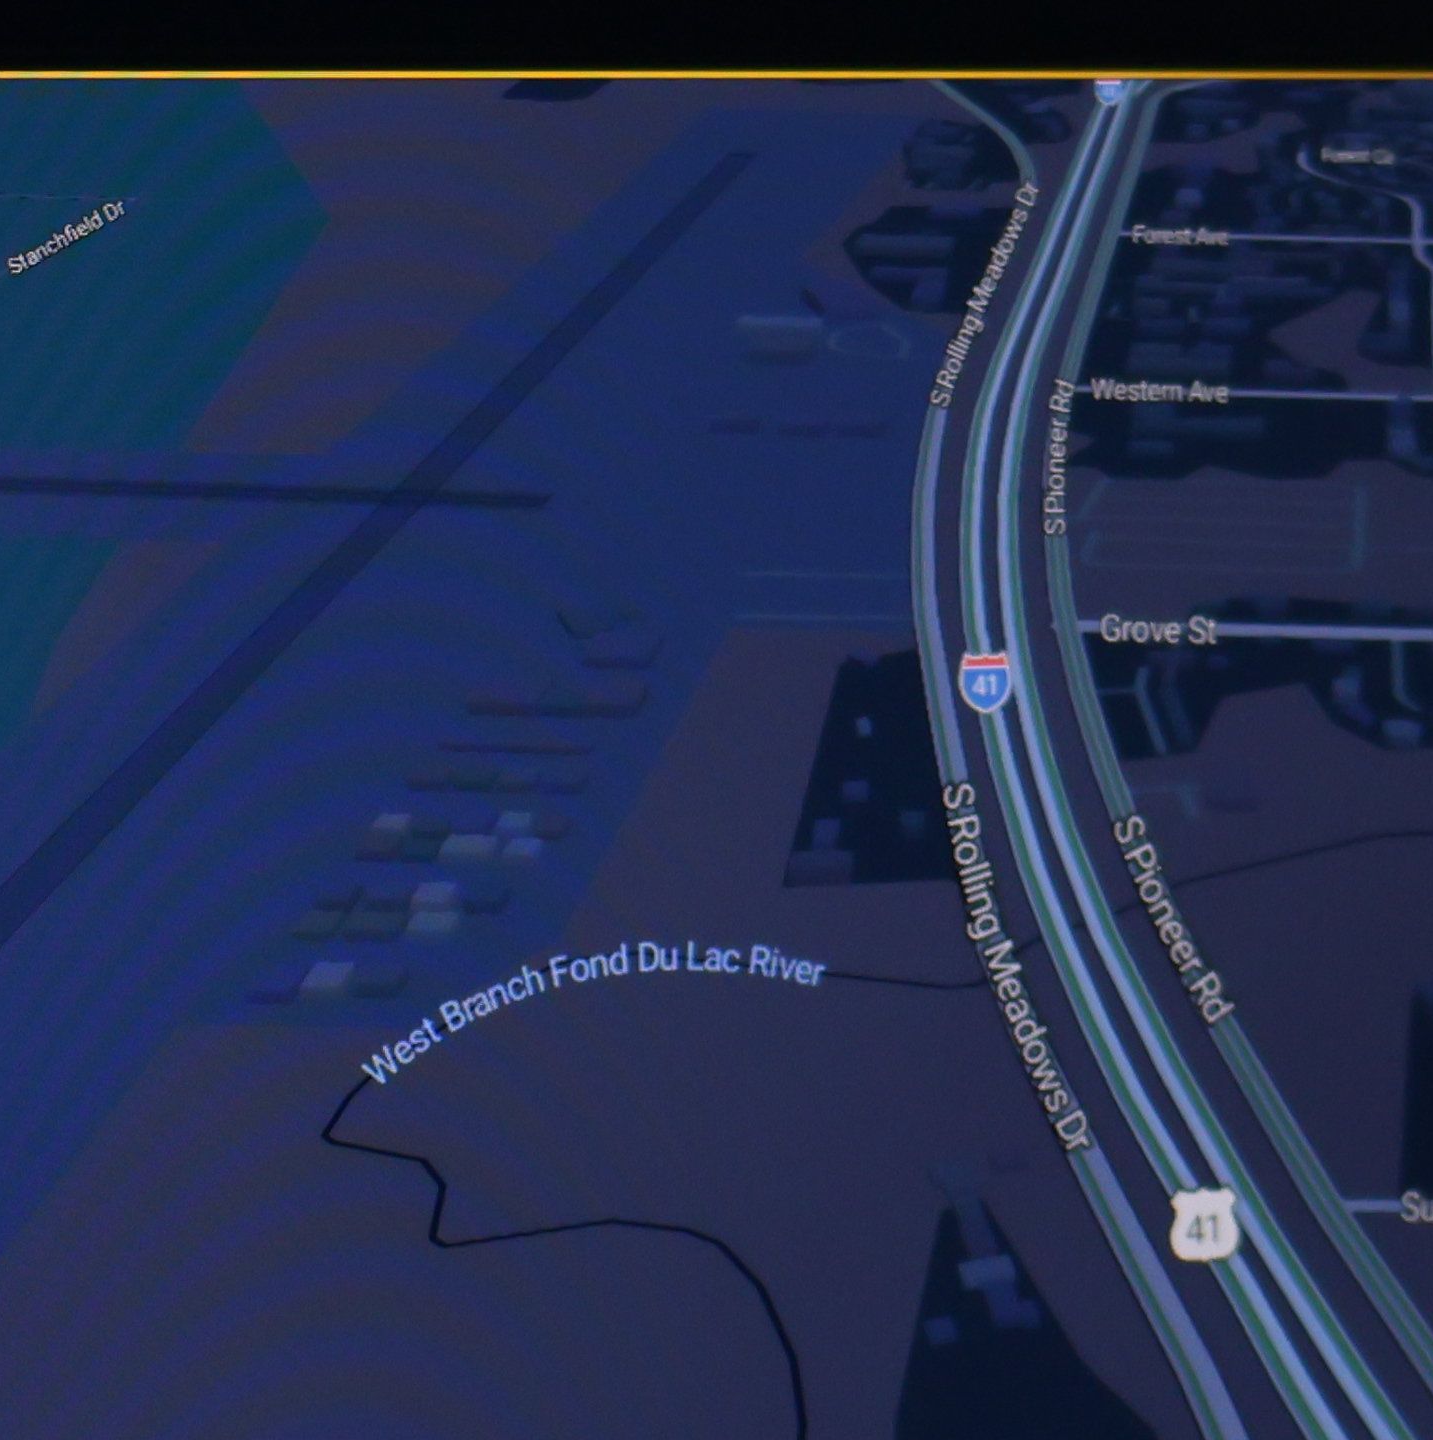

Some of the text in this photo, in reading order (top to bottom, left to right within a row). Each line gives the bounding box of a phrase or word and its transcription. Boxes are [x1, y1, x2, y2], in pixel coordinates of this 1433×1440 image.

[7, 199, 127, 275] Stanchfield Dr
[930, 182, 1040, 407] S Rolling Meadows Dr
[1091, 378, 1230, 404] Western Ave
[1043, 378, 1076, 535] S Pioneer Rd
[1100, 614, 1218, 646] Grove St
[973, 673, 998, 698] 41
[943, 783, 1092, 1153] S Rolling Meadows Dr
[1114, 816, 1235, 1024] S Pioneer Rd
[361, 941, 826, 1084] West Branch Fond Du Lac River
[1186, 1214, 1221, 1244] 41
